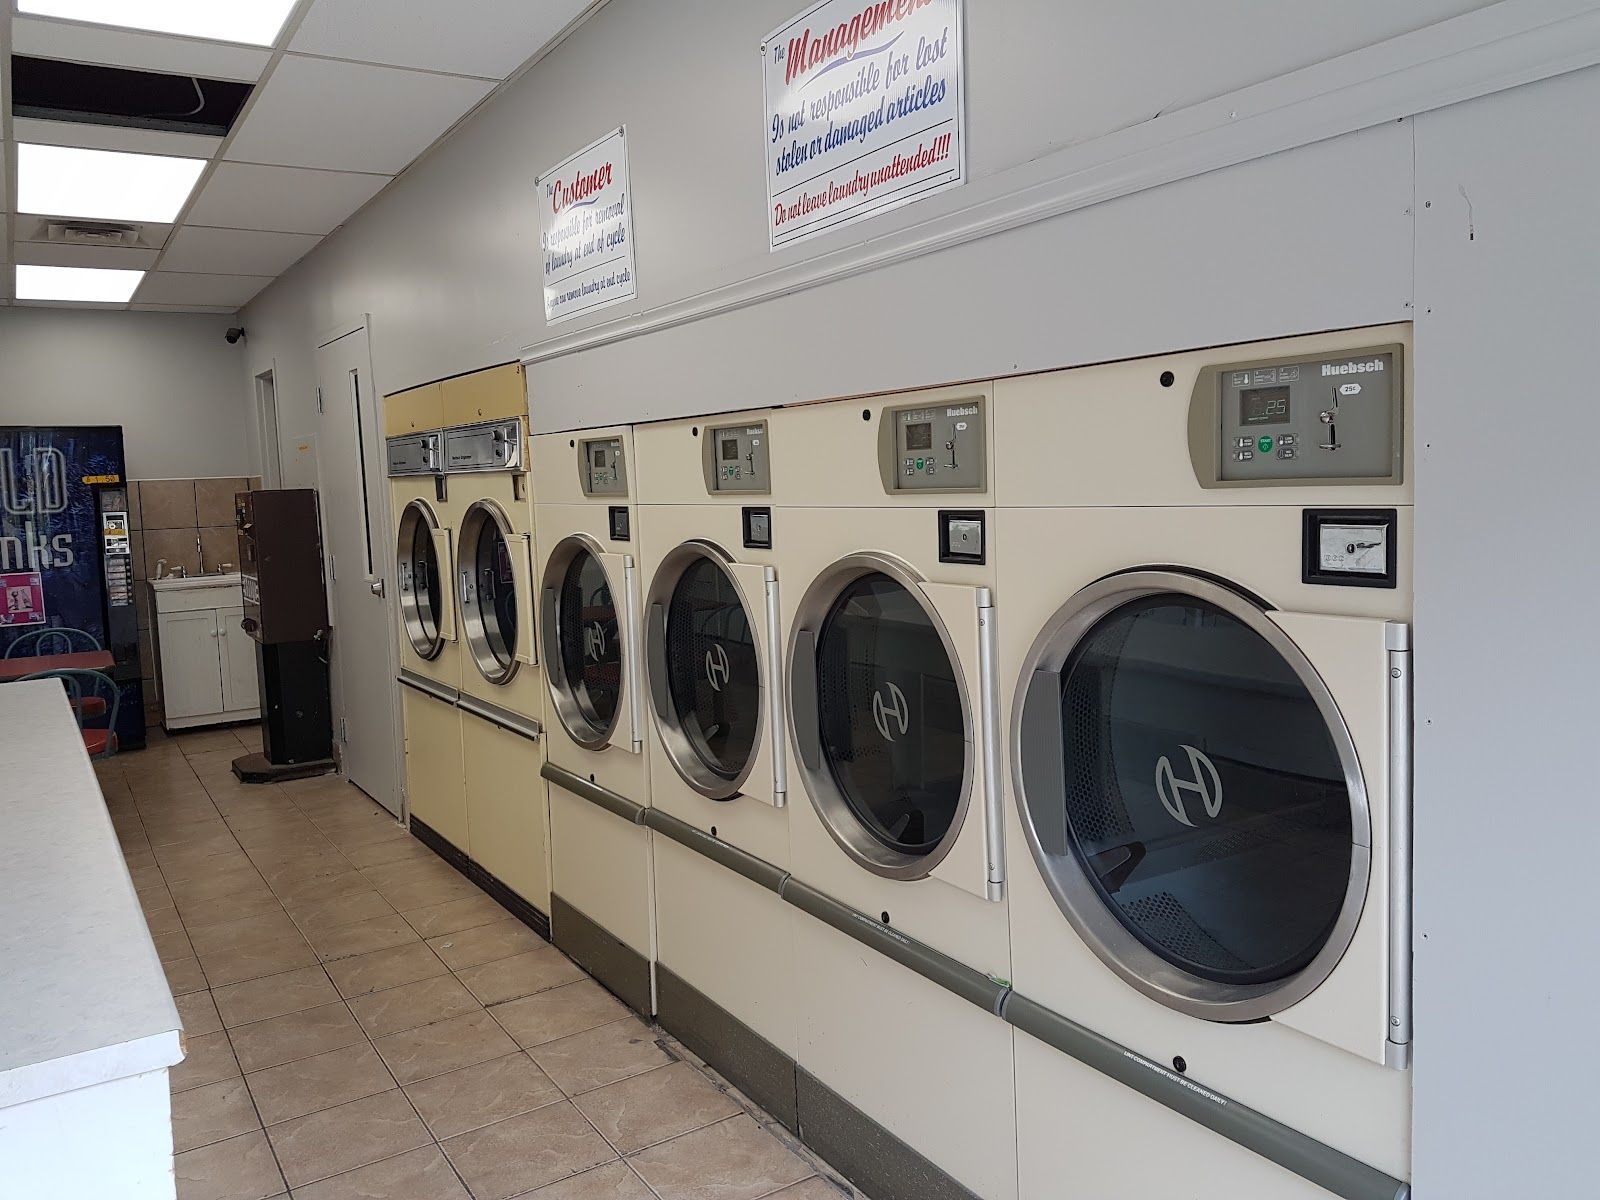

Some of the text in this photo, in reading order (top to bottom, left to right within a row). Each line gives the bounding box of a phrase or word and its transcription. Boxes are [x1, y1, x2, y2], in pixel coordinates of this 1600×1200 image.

[774, 0, 931, 85] The Managemen
[772, 26, 948, 143] Is not responsible for lost
[776, 74, 946, 176] stolen or damaged articles
[552, 161, 613, 214] Customer
[774, 132, 951, 226] Do not leave laundry unattended!!!
[595, 193, 625, 225] removal
[551, 246, 573, 272] laundry
[574, 240, 581, 261] at
[583, 233, 595, 258] end
[596, 229, 605, 253] of
[606, 222, 626, 251] cycle
[581, 278, 600, 296] laundry
[616, 268, 631, 287] cycle
[1321, 359, 1384, 377] Huebsch
[1187, 1082, 1210, 1098] CLEANED
